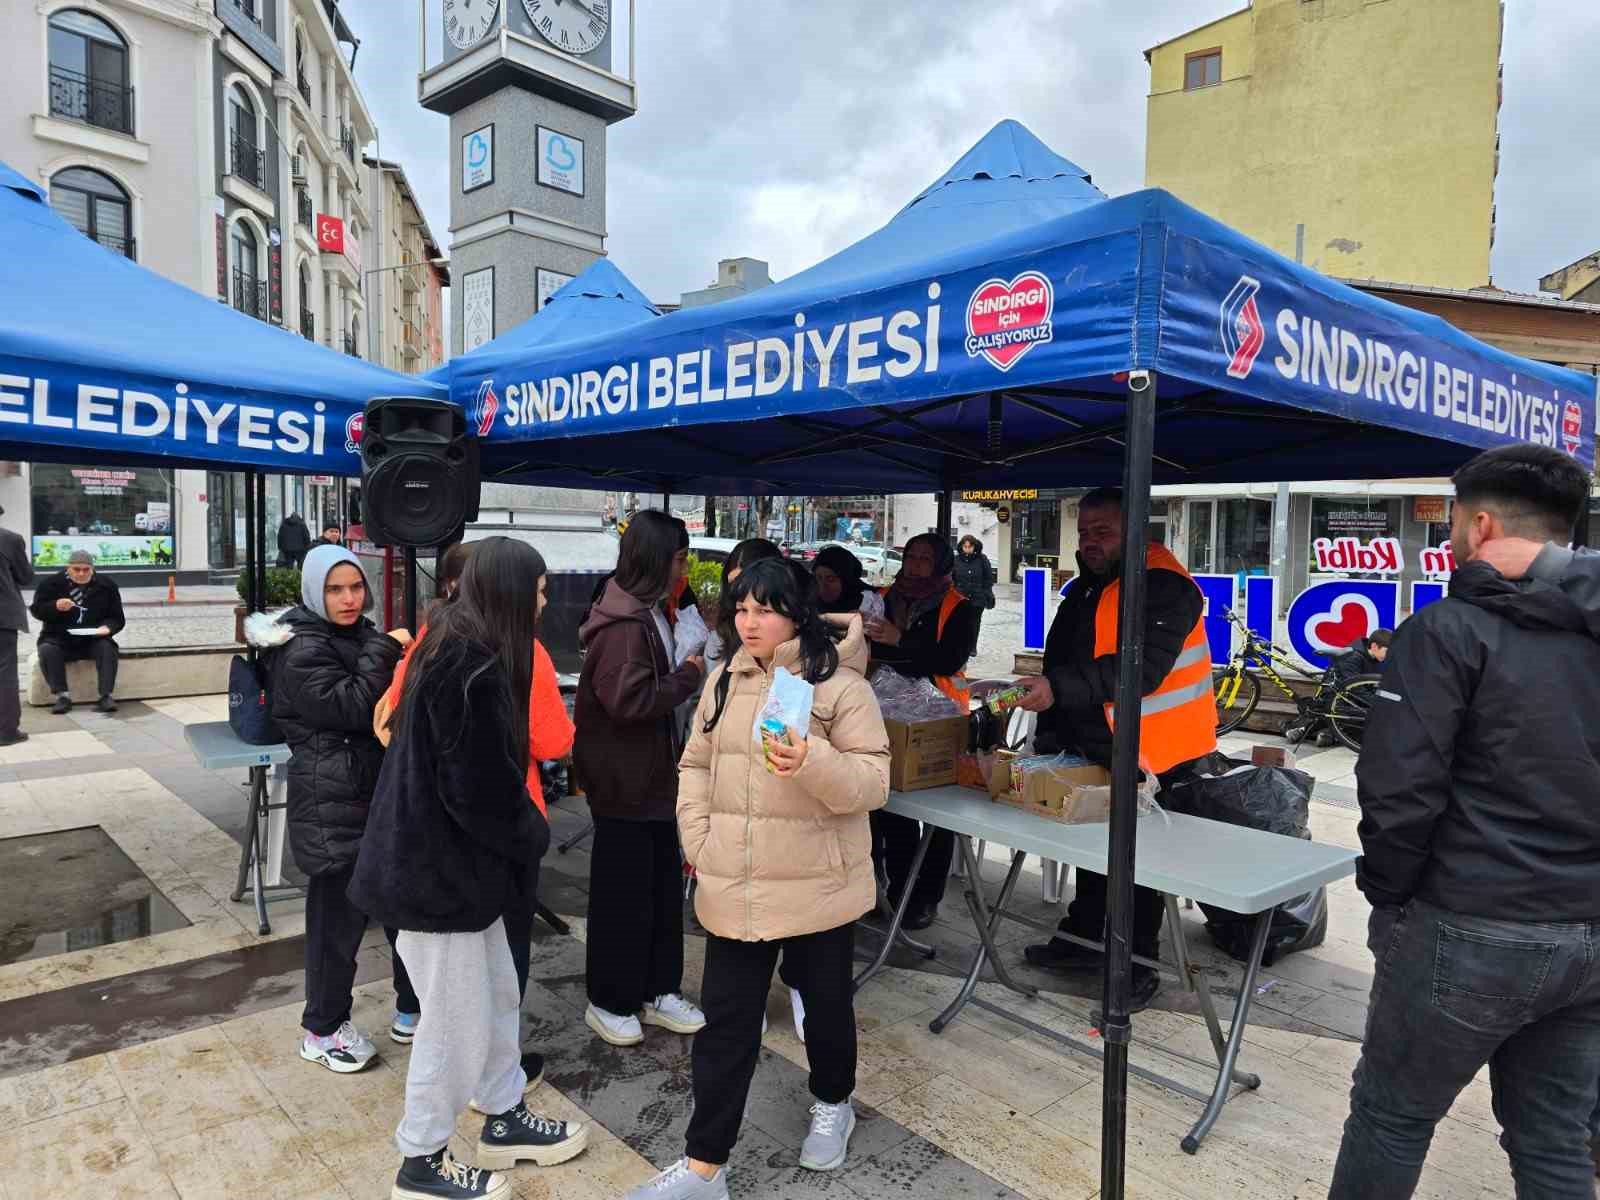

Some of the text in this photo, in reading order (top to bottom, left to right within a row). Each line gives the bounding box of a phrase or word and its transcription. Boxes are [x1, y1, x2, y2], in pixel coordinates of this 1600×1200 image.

[968, 325, 1050, 353] ÇALIŞIYORUZ
[974, 287, 1044, 316] SINDIRGI
[504, 281, 942, 427] SINDIRGI BELEDİYESİ
[1275, 308, 1559, 449] SINDIRGI BELEDİYESİ
